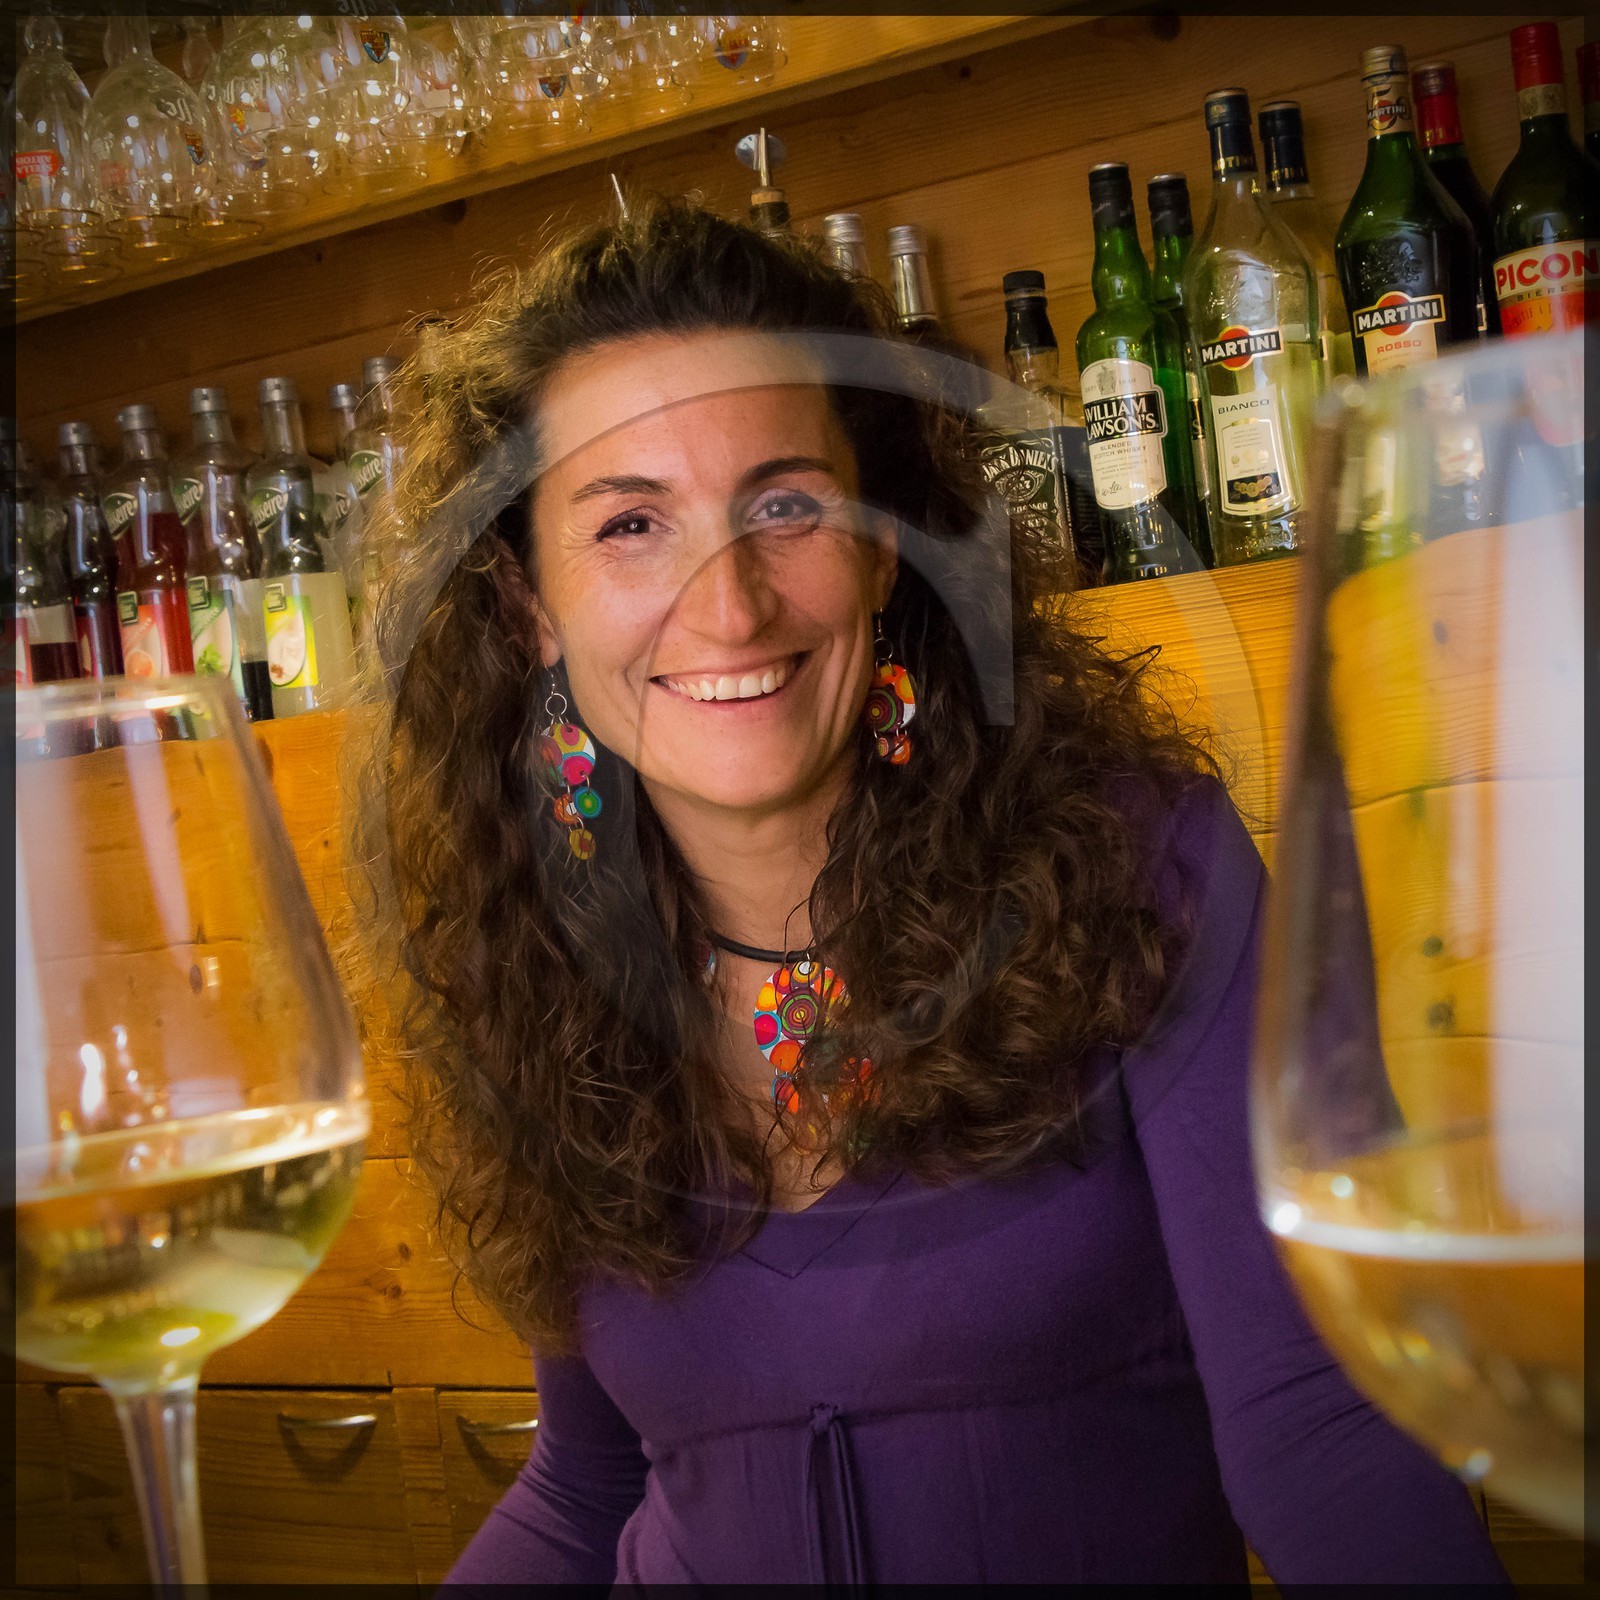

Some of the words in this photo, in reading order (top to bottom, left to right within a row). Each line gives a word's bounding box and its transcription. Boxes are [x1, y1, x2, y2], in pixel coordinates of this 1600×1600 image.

[1496, 247, 1600, 296] PICON
[1358, 301, 1439, 331] MARTINI
[1201, 334, 1277, 363] MARTINI
[1376, 339, 1422, 355] ROSSO
[1085, 396, 1148, 423] WILLIAM
[1217, 398, 1270, 415] BIANCO
